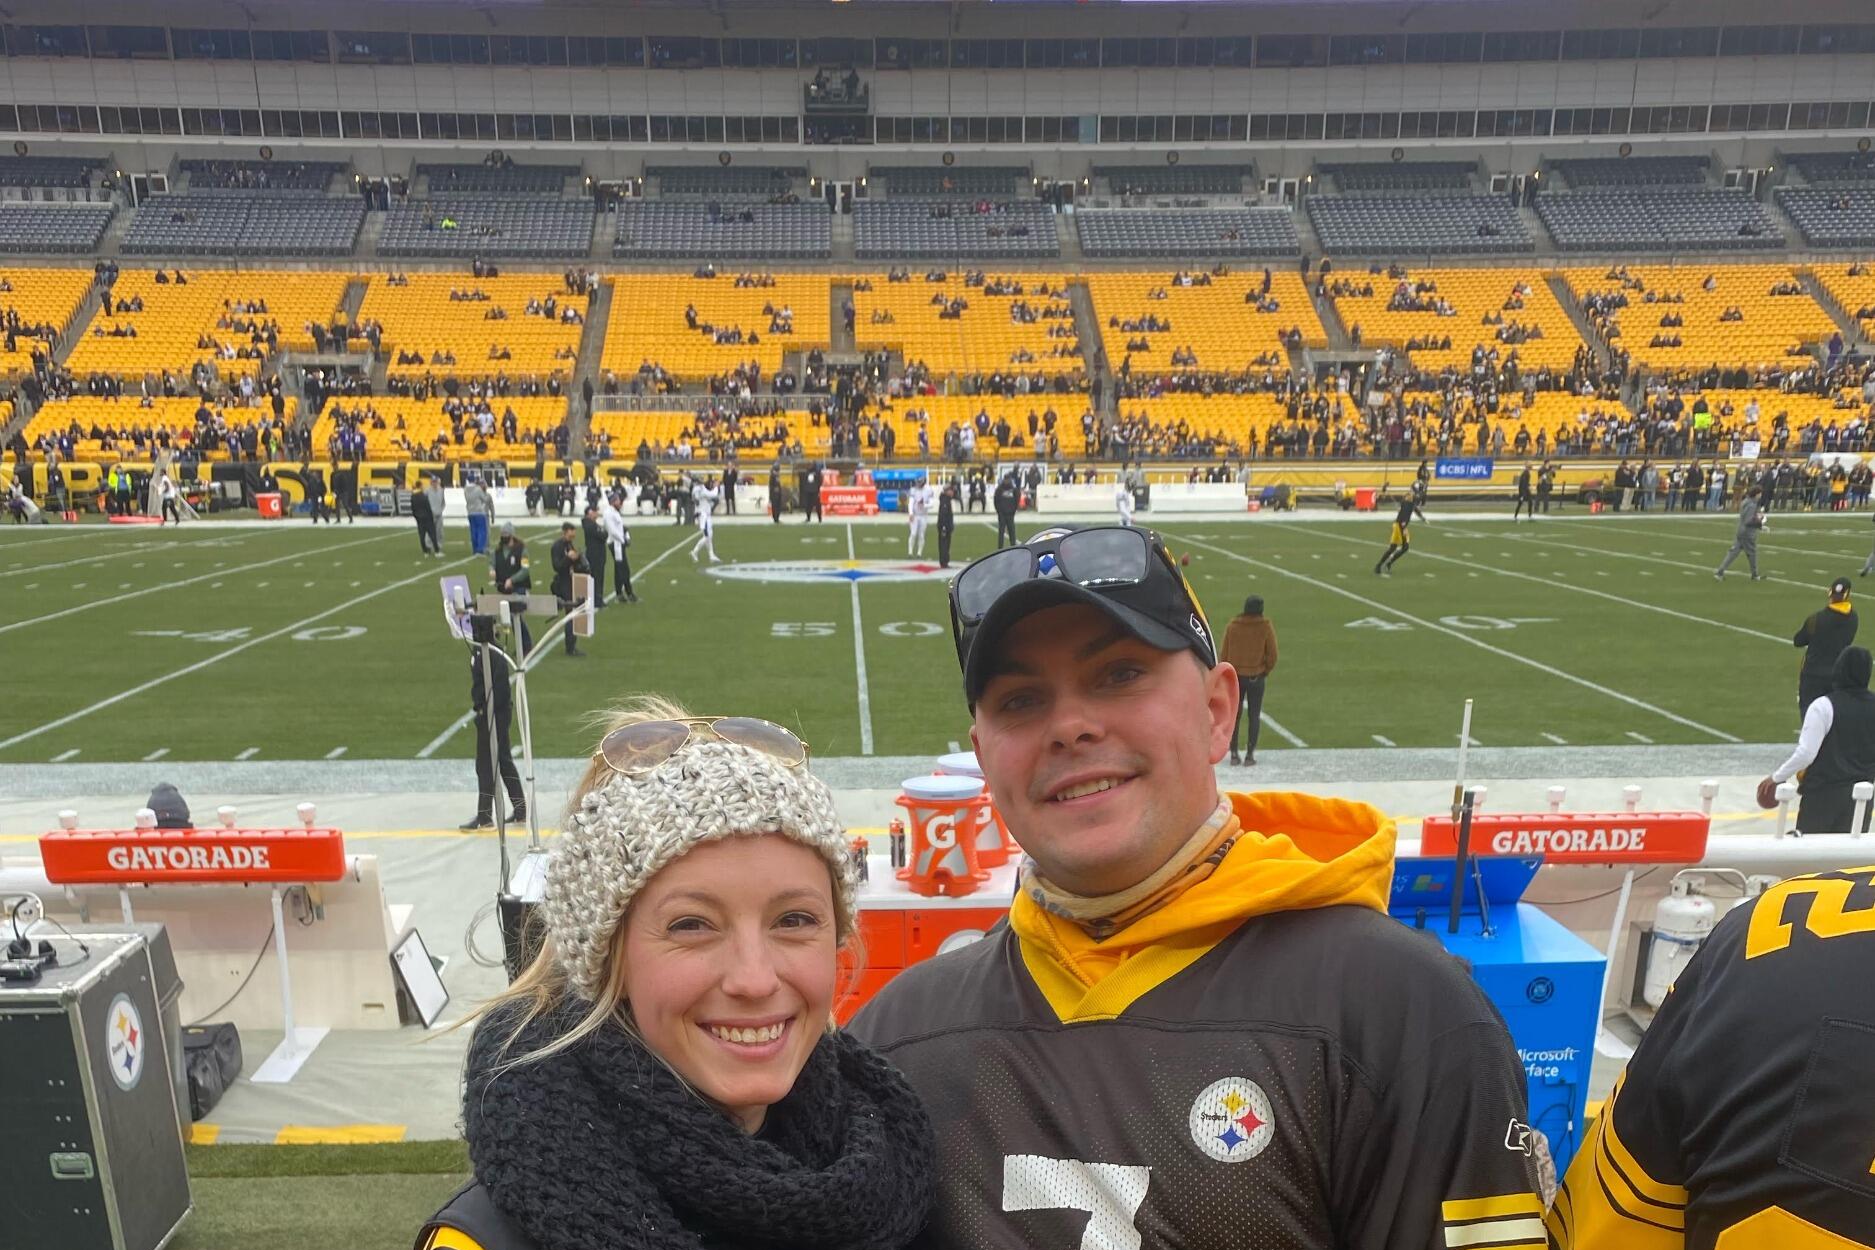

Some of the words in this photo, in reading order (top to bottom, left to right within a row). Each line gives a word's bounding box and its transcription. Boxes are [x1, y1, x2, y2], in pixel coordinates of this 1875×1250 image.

[1446, 464, 1465, 475] CBS
[1469, 465, 1488, 475] NFL
[828, 494, 866, 504] GATORADE
[926, 815, 956, 849] G
[1491, 828, 1647, 853] GATORADE
[107, 845, 270, 870] GATORADE
